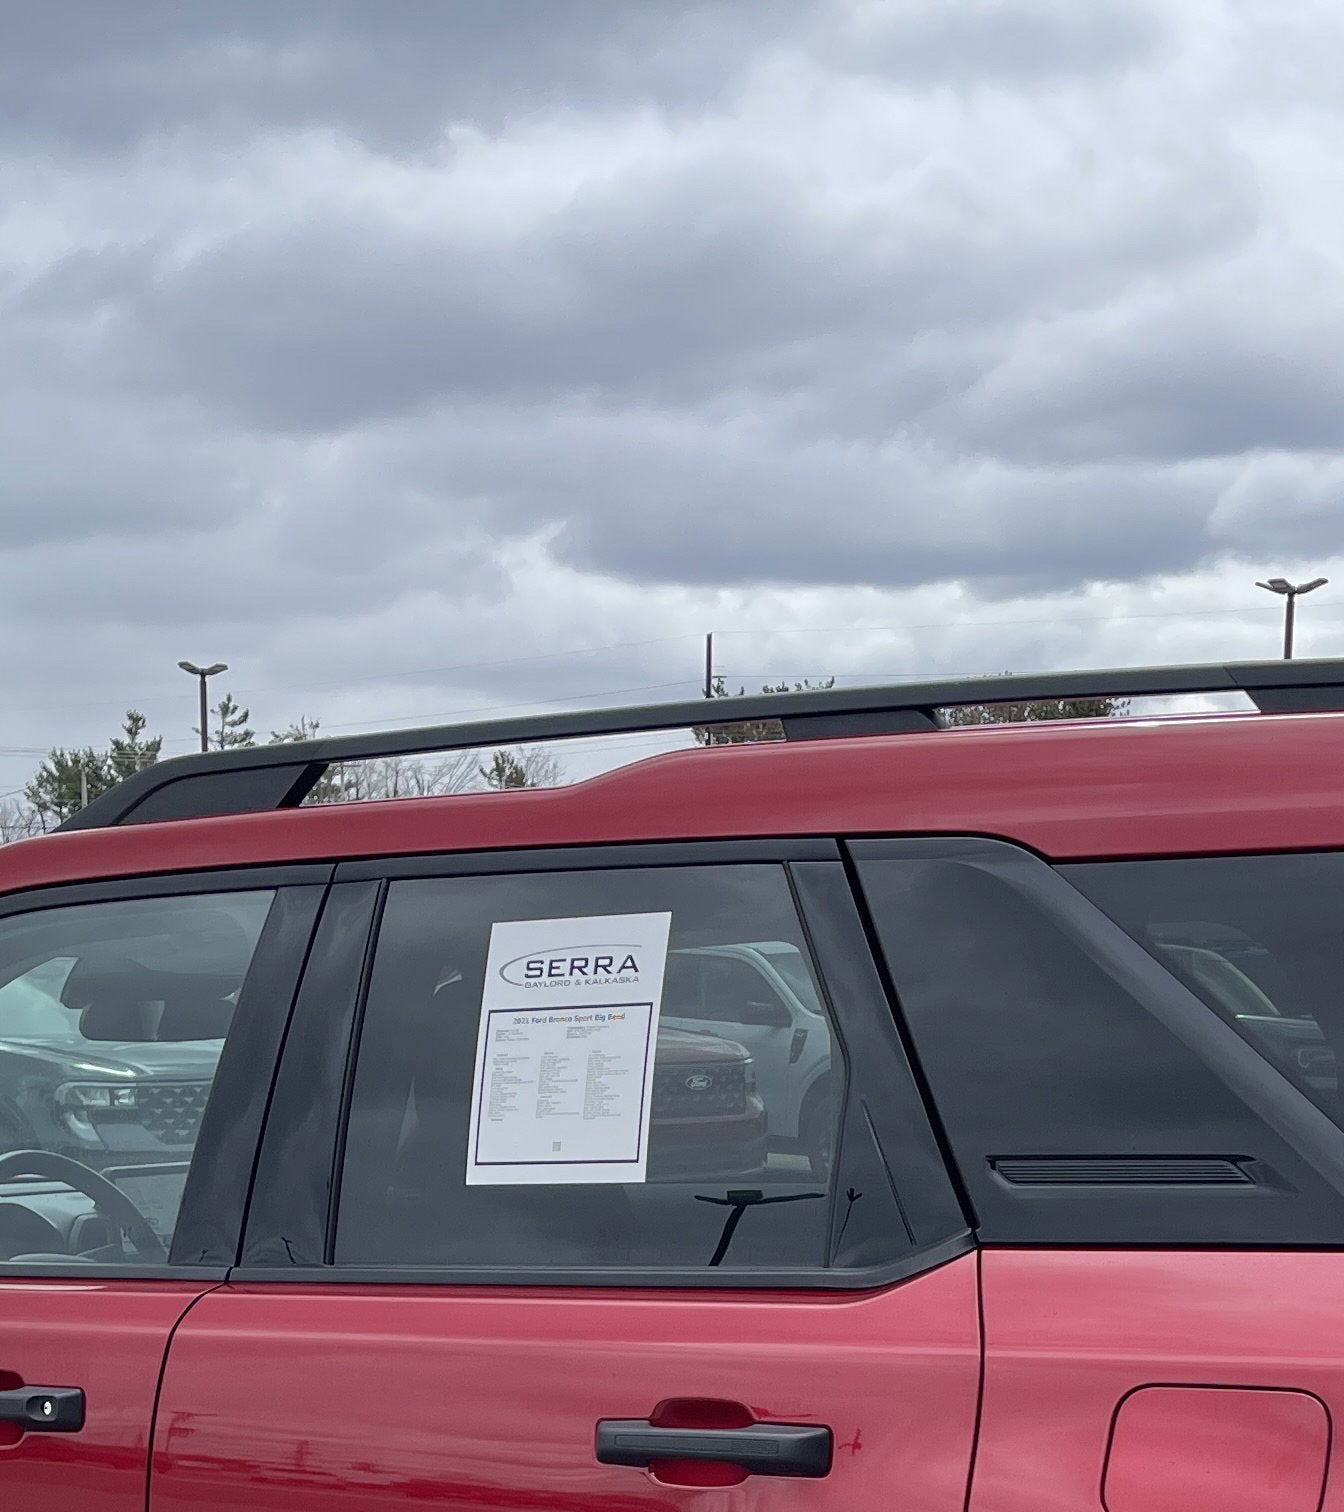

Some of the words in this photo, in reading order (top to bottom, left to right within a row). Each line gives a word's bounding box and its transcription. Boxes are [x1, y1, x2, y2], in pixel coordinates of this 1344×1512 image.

[524, 953, 640, 979] SERRA
[524, 979, 571, 989] GAYLORD
[574, 978, 582, 986] &
[584, 976, 640, 985] KALKASKA
[531, 1015, 548, 1024] Ford
[574, 1014, 593, 1024] Sport
